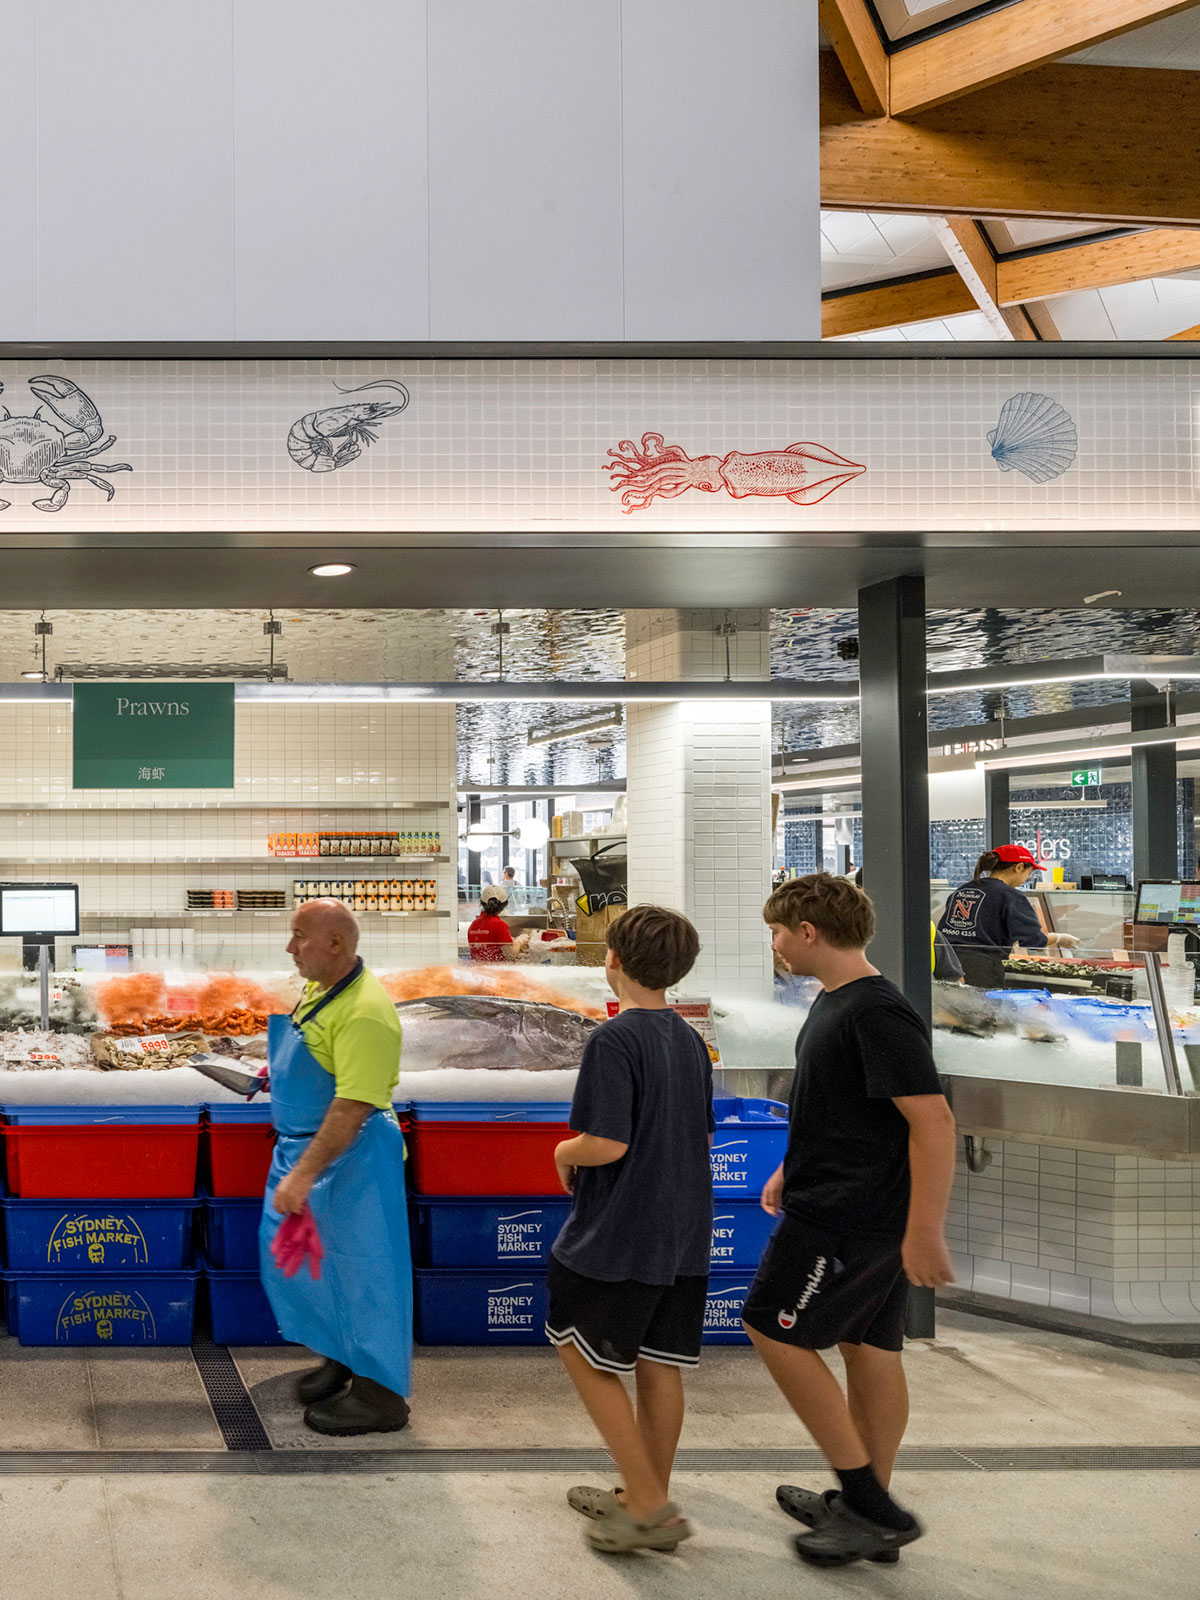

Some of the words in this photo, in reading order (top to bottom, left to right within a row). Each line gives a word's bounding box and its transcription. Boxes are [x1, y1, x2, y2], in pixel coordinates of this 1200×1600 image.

[116, 698, 190, 716] Prawns
[137, 767, 166, 781] 海虾
[141, 1040, 168, 1052] 5999
[710, 1153, 748, 1163] YDNEY
[710, 1163, 728, 1172] ISH
[712, 1171, 748, 1181] ARKET
[65, 1218, 124, 1234] SYDNEY
[497, 1224, 542, 1233] SYDNEY
[497, 1233, 522, 1243] FISH
[712, 1228, 734, 1238] NEY
[53, 1234, 83, 1252] FISH
[86, 1232, 140, 1246] MARKET
[497, 1242, 542, 1252] MARKET
[778, 1255, 827, 1330] Champion
[73, 1294, 131, 1311] SYDNEY
[487, 1296, 533, 1306] SYDNEY
[487, 1306, 513, 1315] FISH
[61, 1311, 92, 1329] FISH
[94, 1308, 148, 1322] MARKET
[487, 1315, 533, 1324] MARKET
[703, 1317, 743, 1327] MARKE
